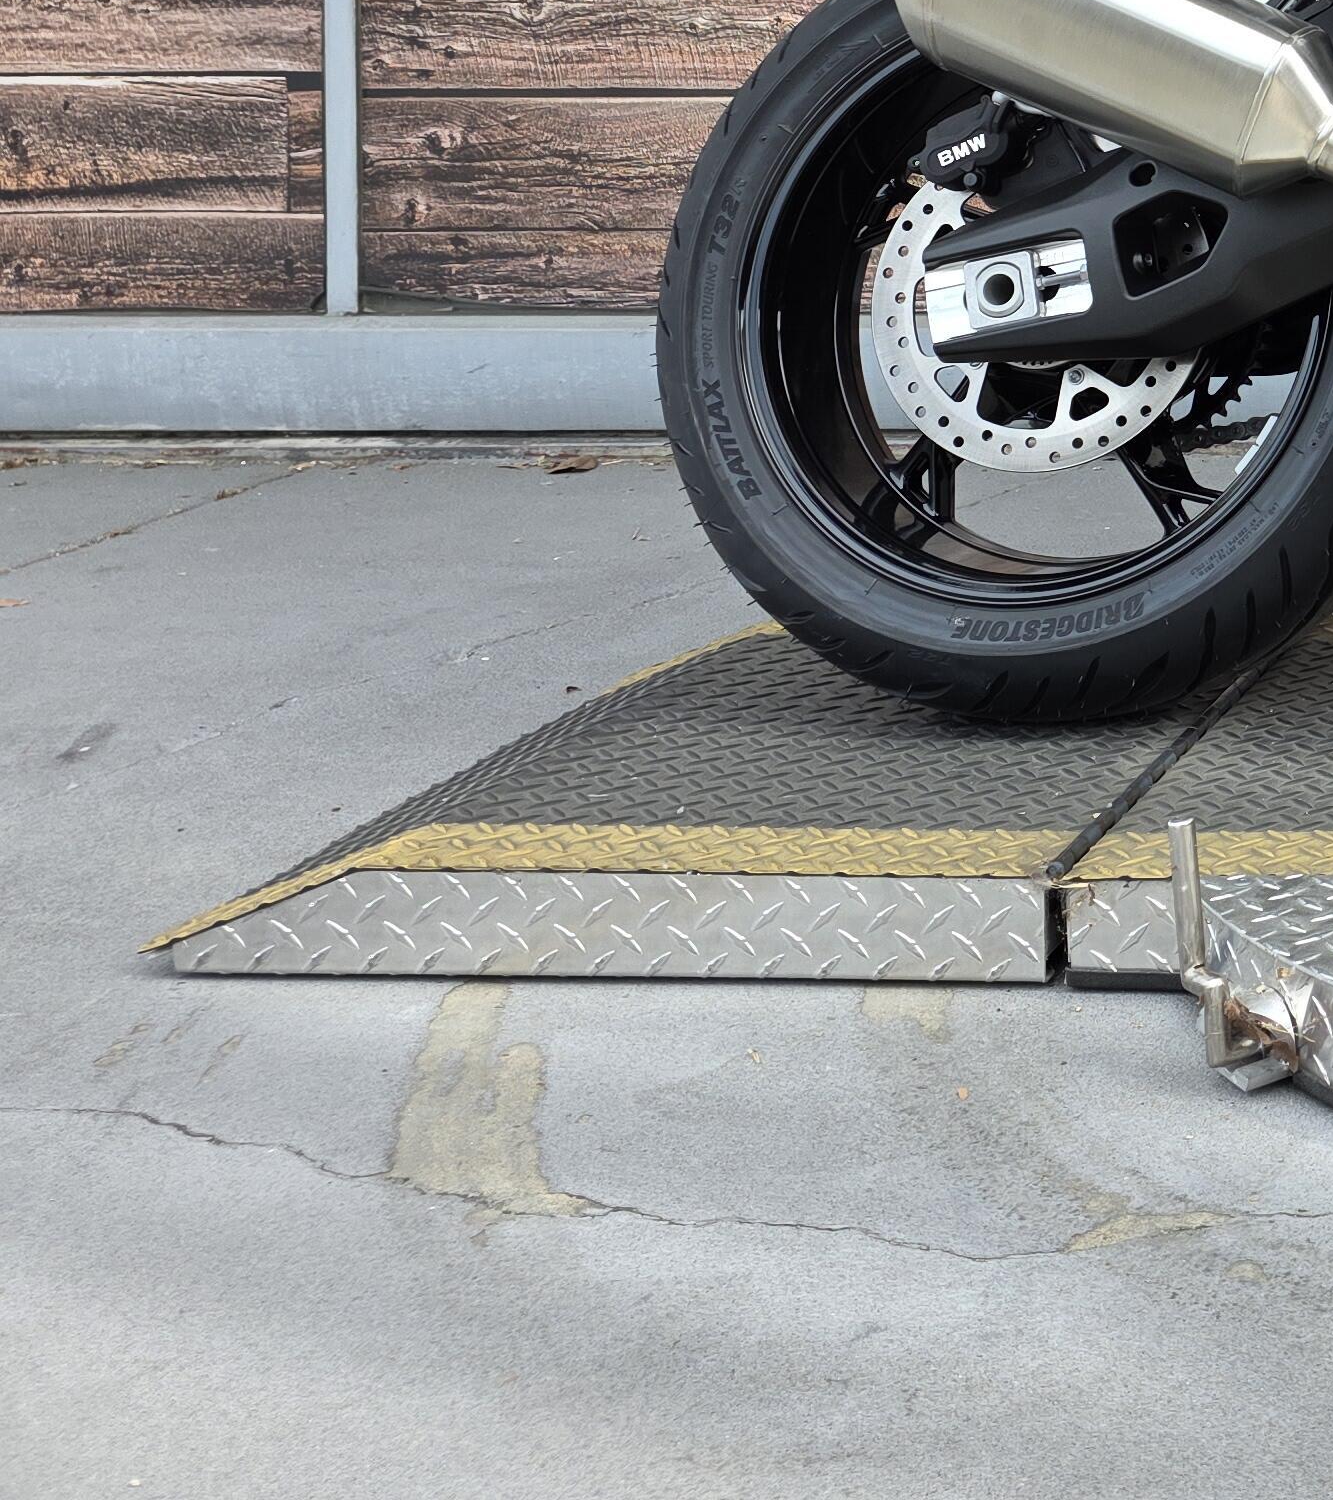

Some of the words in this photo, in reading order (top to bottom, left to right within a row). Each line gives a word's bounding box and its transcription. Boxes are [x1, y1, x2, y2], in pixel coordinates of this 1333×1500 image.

[936, 133, 987, 167] BMW
[701, 378, 763, 501] BATTLAX
[950, 591, 1146, 642] BRIDGESTONE
